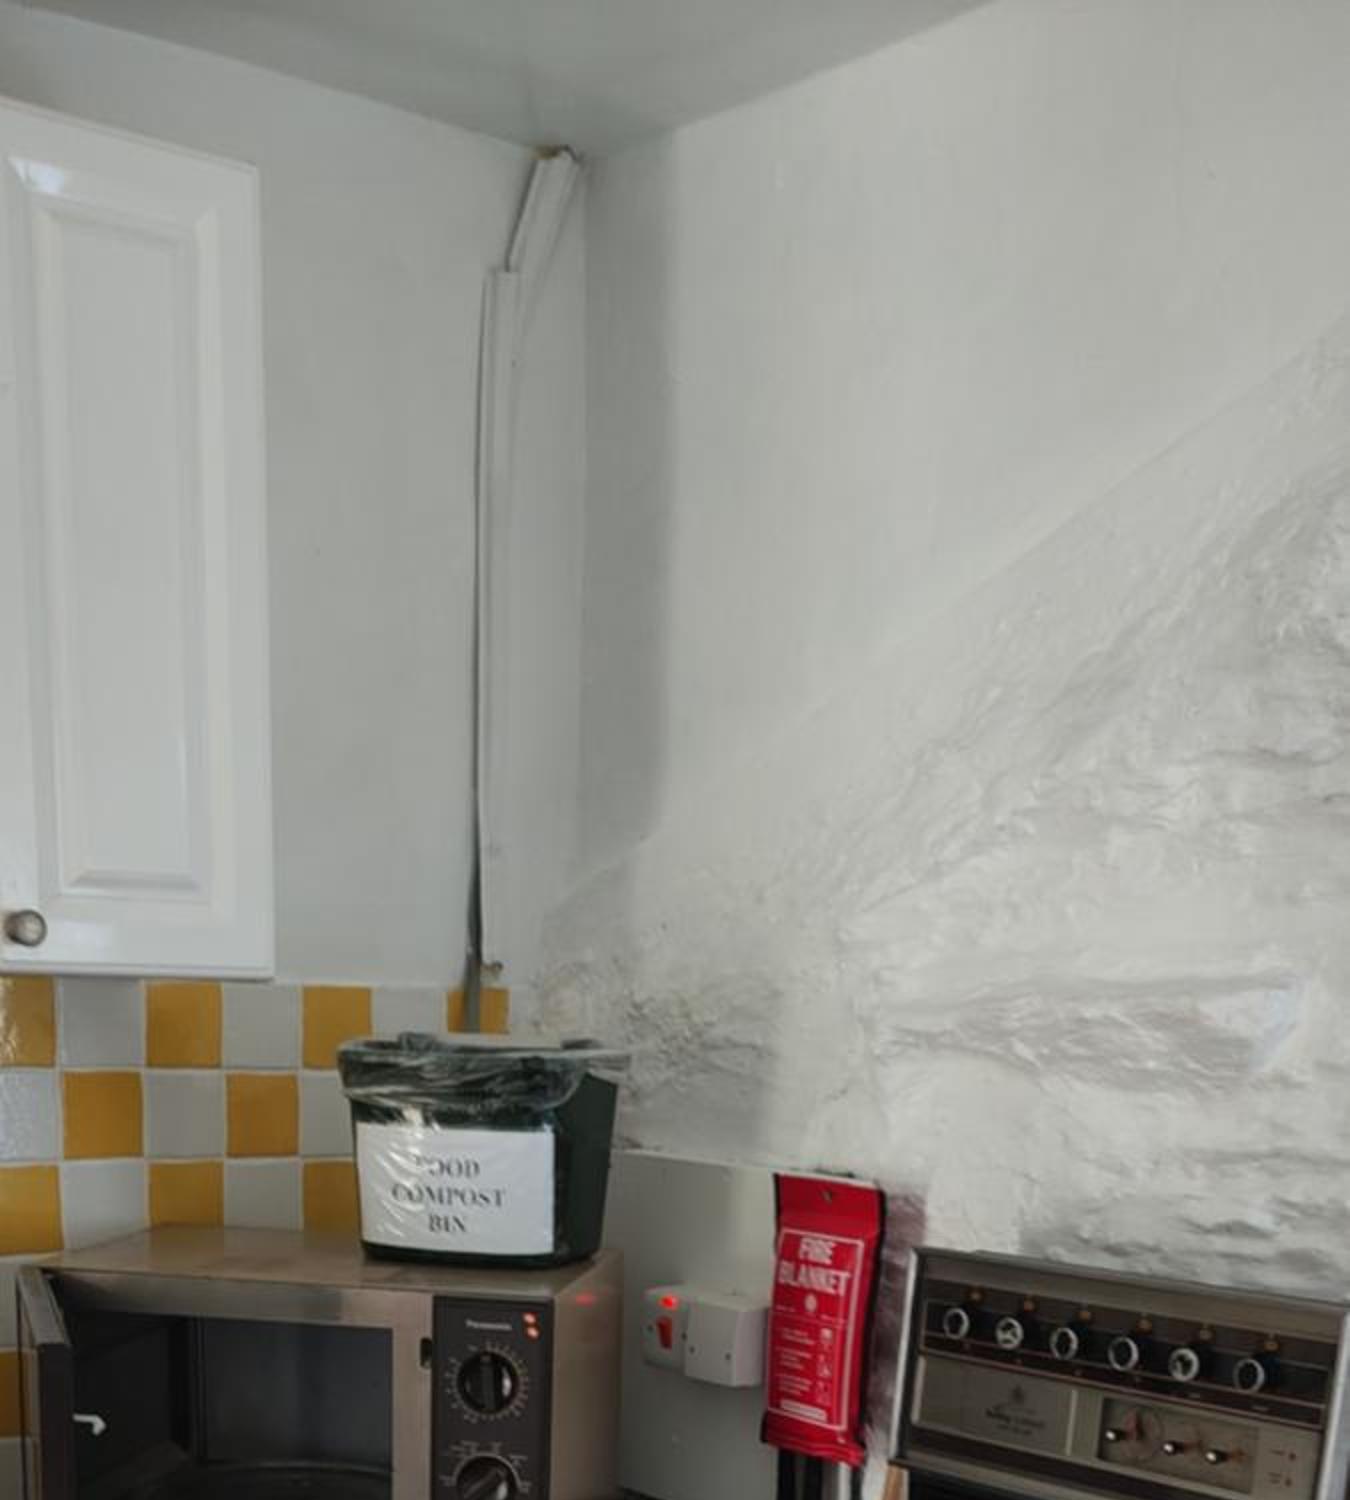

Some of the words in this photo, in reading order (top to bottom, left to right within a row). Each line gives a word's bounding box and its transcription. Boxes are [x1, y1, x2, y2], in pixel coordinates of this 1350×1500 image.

[391, 1183, 507, 1207] COMPOST
[428, 1213, 467, 1233] BIN
[799, 1236, 836, 1265] FIRE
[779, 1261, 849, 1296] BLANKET
